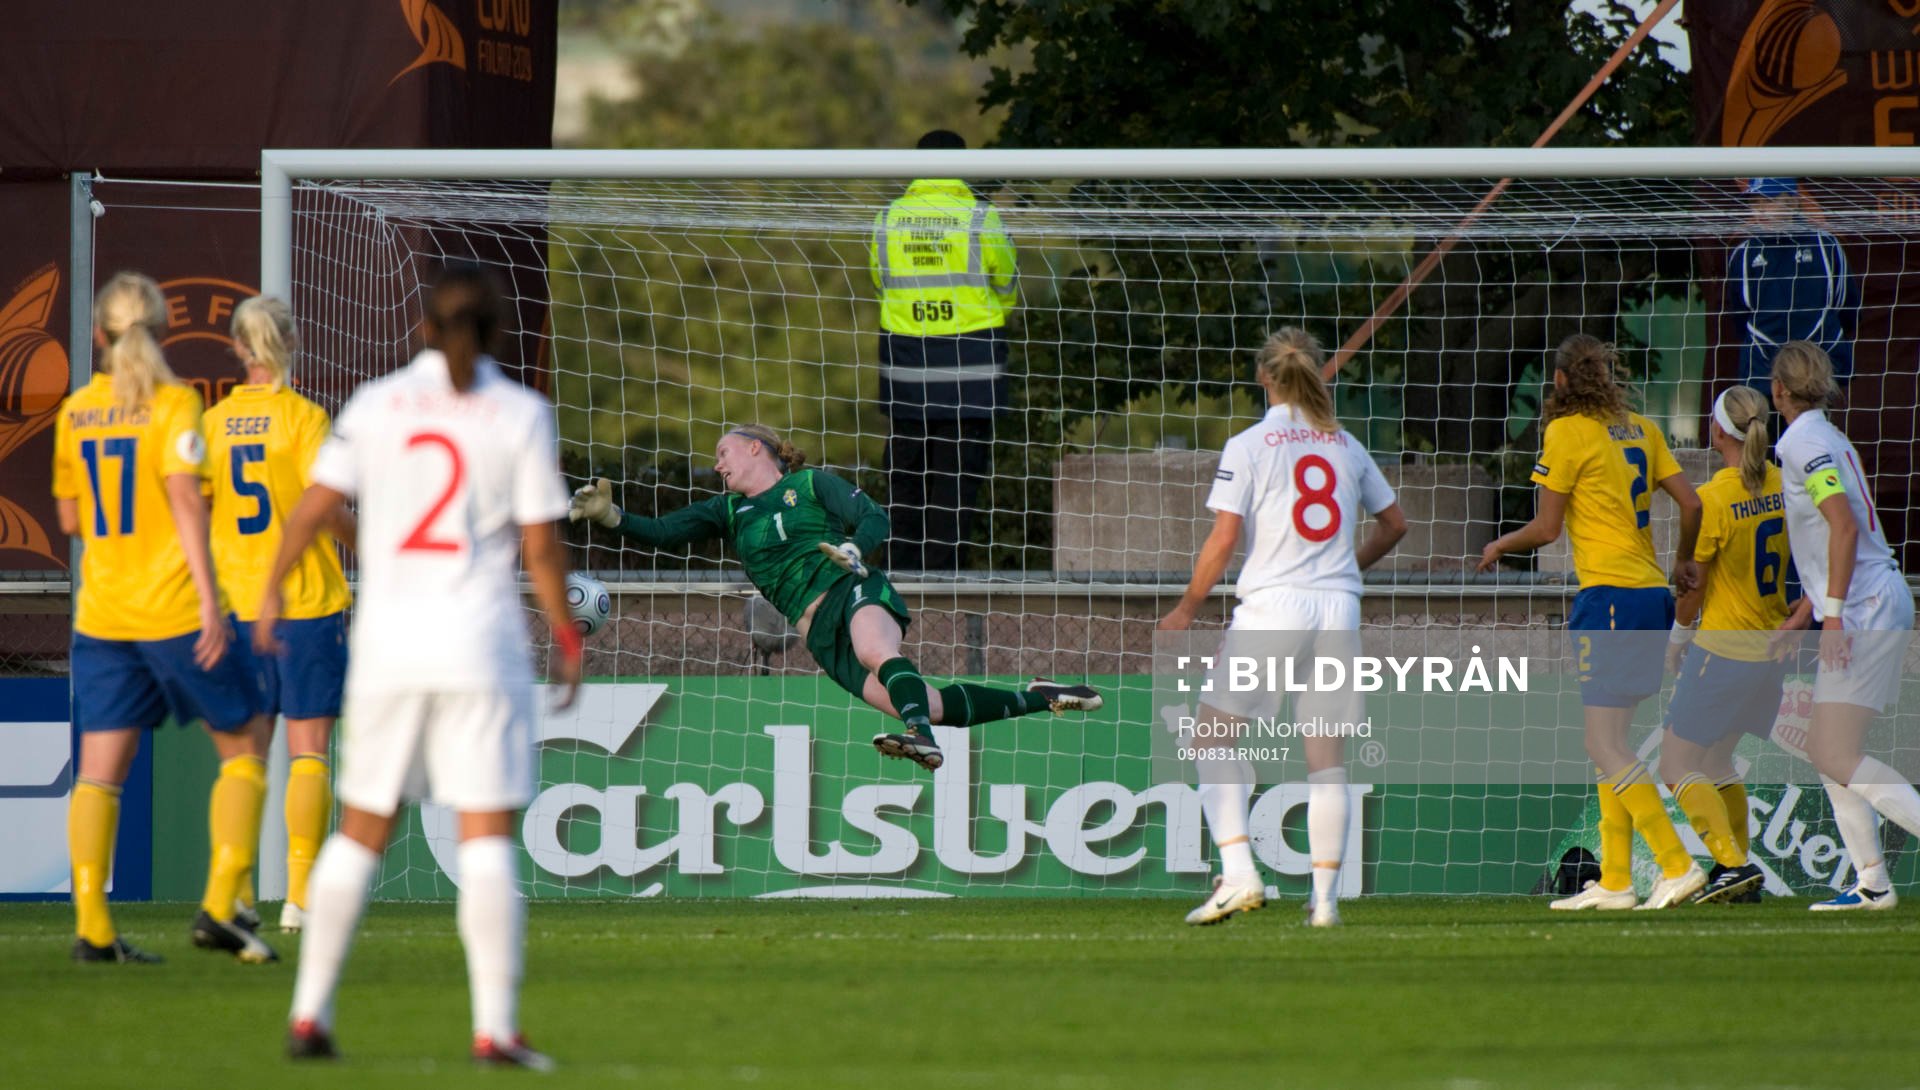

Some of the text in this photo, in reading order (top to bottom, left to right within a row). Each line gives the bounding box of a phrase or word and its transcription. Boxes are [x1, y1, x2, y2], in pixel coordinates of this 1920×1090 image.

[912, 255, 944, 267] SECURITY
[911, 299, 954, 322] 659
[225, 416, 271, 436] SEGER
[1263, 428, 1349, 448] CHAPMAN
[80, 437, 138, 537] 17
[230, 443, 273, 536] 5
[399, 430, 467, 553] 2
[773, 511, 788, 542] 1
[1292, 453, 1342, 543] 8
[1622, 446, 1650, 529] 2
[1755, 517, 1784, 598] 6
